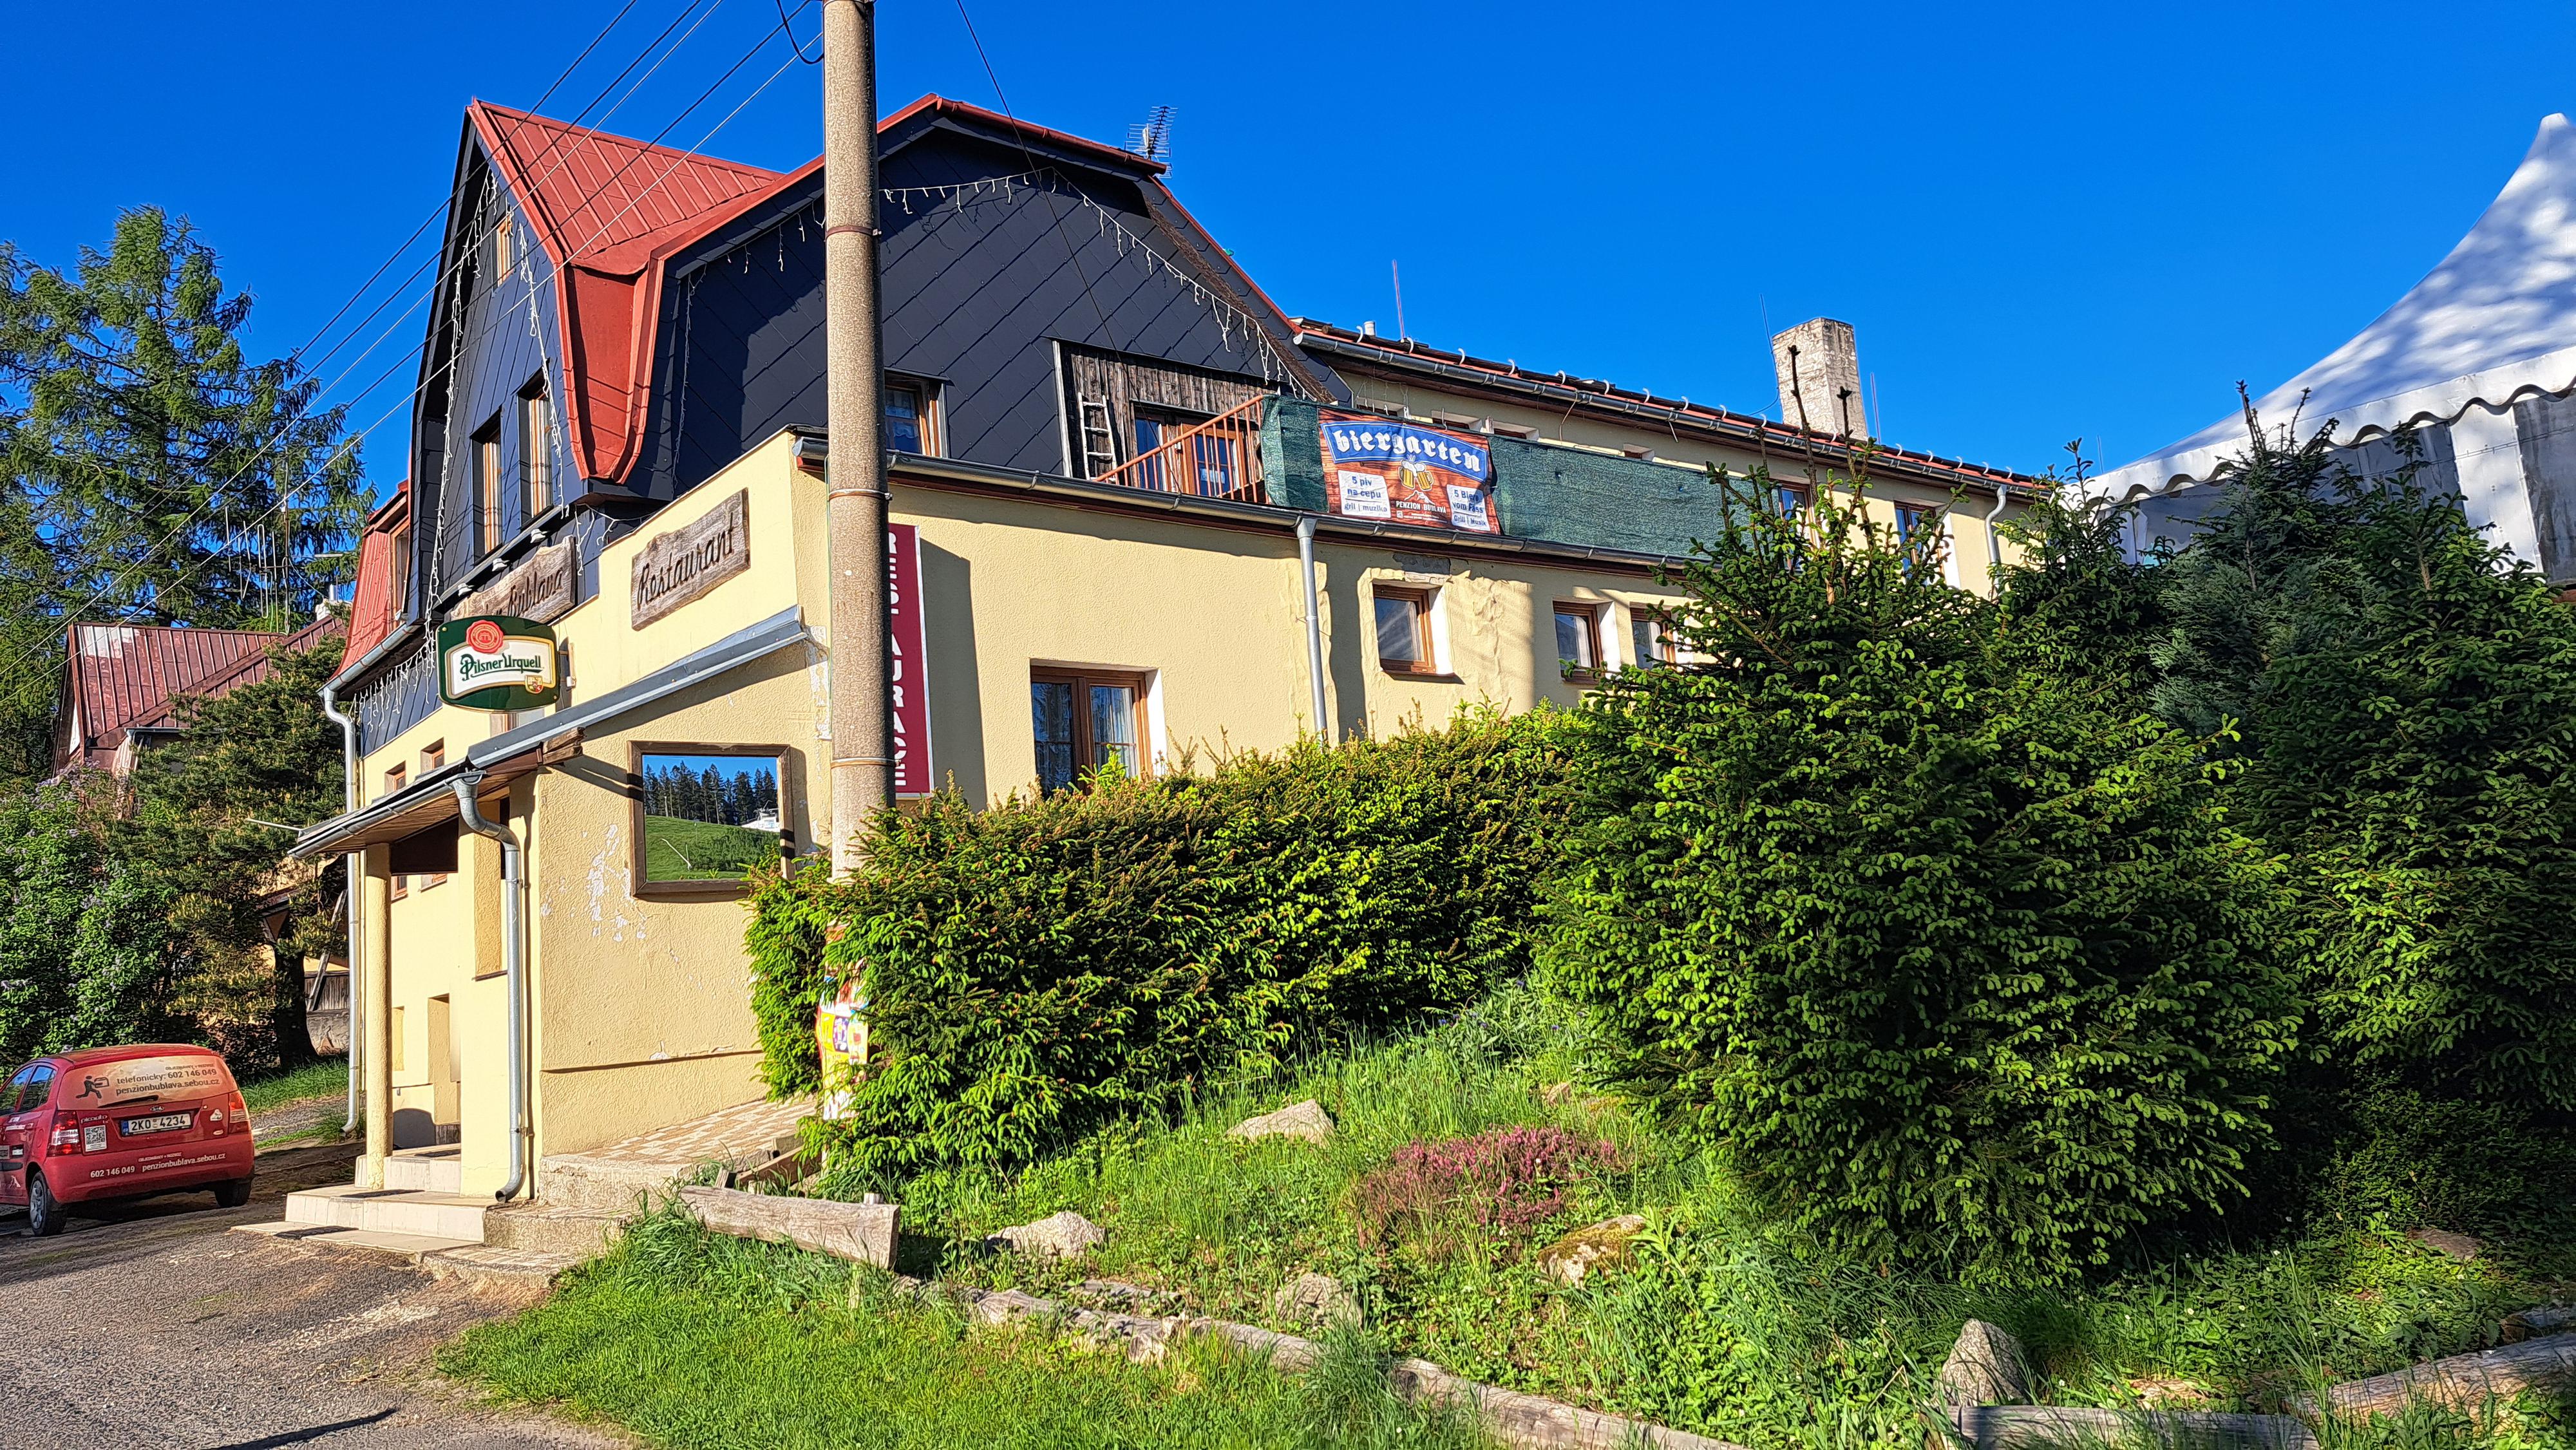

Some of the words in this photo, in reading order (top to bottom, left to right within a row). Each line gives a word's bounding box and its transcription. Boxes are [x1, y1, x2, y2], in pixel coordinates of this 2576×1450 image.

[1332, 429, 1481, 473] biergarten
[1351, 476, 1358, 484] 5
[1359, 477, 1372, 487] piv
[1454, 489, 1459, 498] 5
[1396, 500, 1421, 510] PENZION
[1423, 504, 1446, 514] BUBLAVA
[1452, 501, 1467, 509] vom
[1468, 503, 1484, 514] Fass
[637, 512, 741, 611] Restaurant
[507, 567, 564, 617] Bublava
[460, 653, 503, 681] Pilsner
[502, 652, 542, 673] Urquell
[117, 1073, 166, 1084] telefonicky:
[116, 1078, 220, 1096] penzionbublava.sebou.cz
[160, 1115, 185, 1127] 4234
[142, 1153, 226, 1172] penzionbublava.sebou.cz
[90, 1169, 104, 1178] 602
[107, 1167, 120, 1176] 146
[121, 1165, 135, 1174] 049
